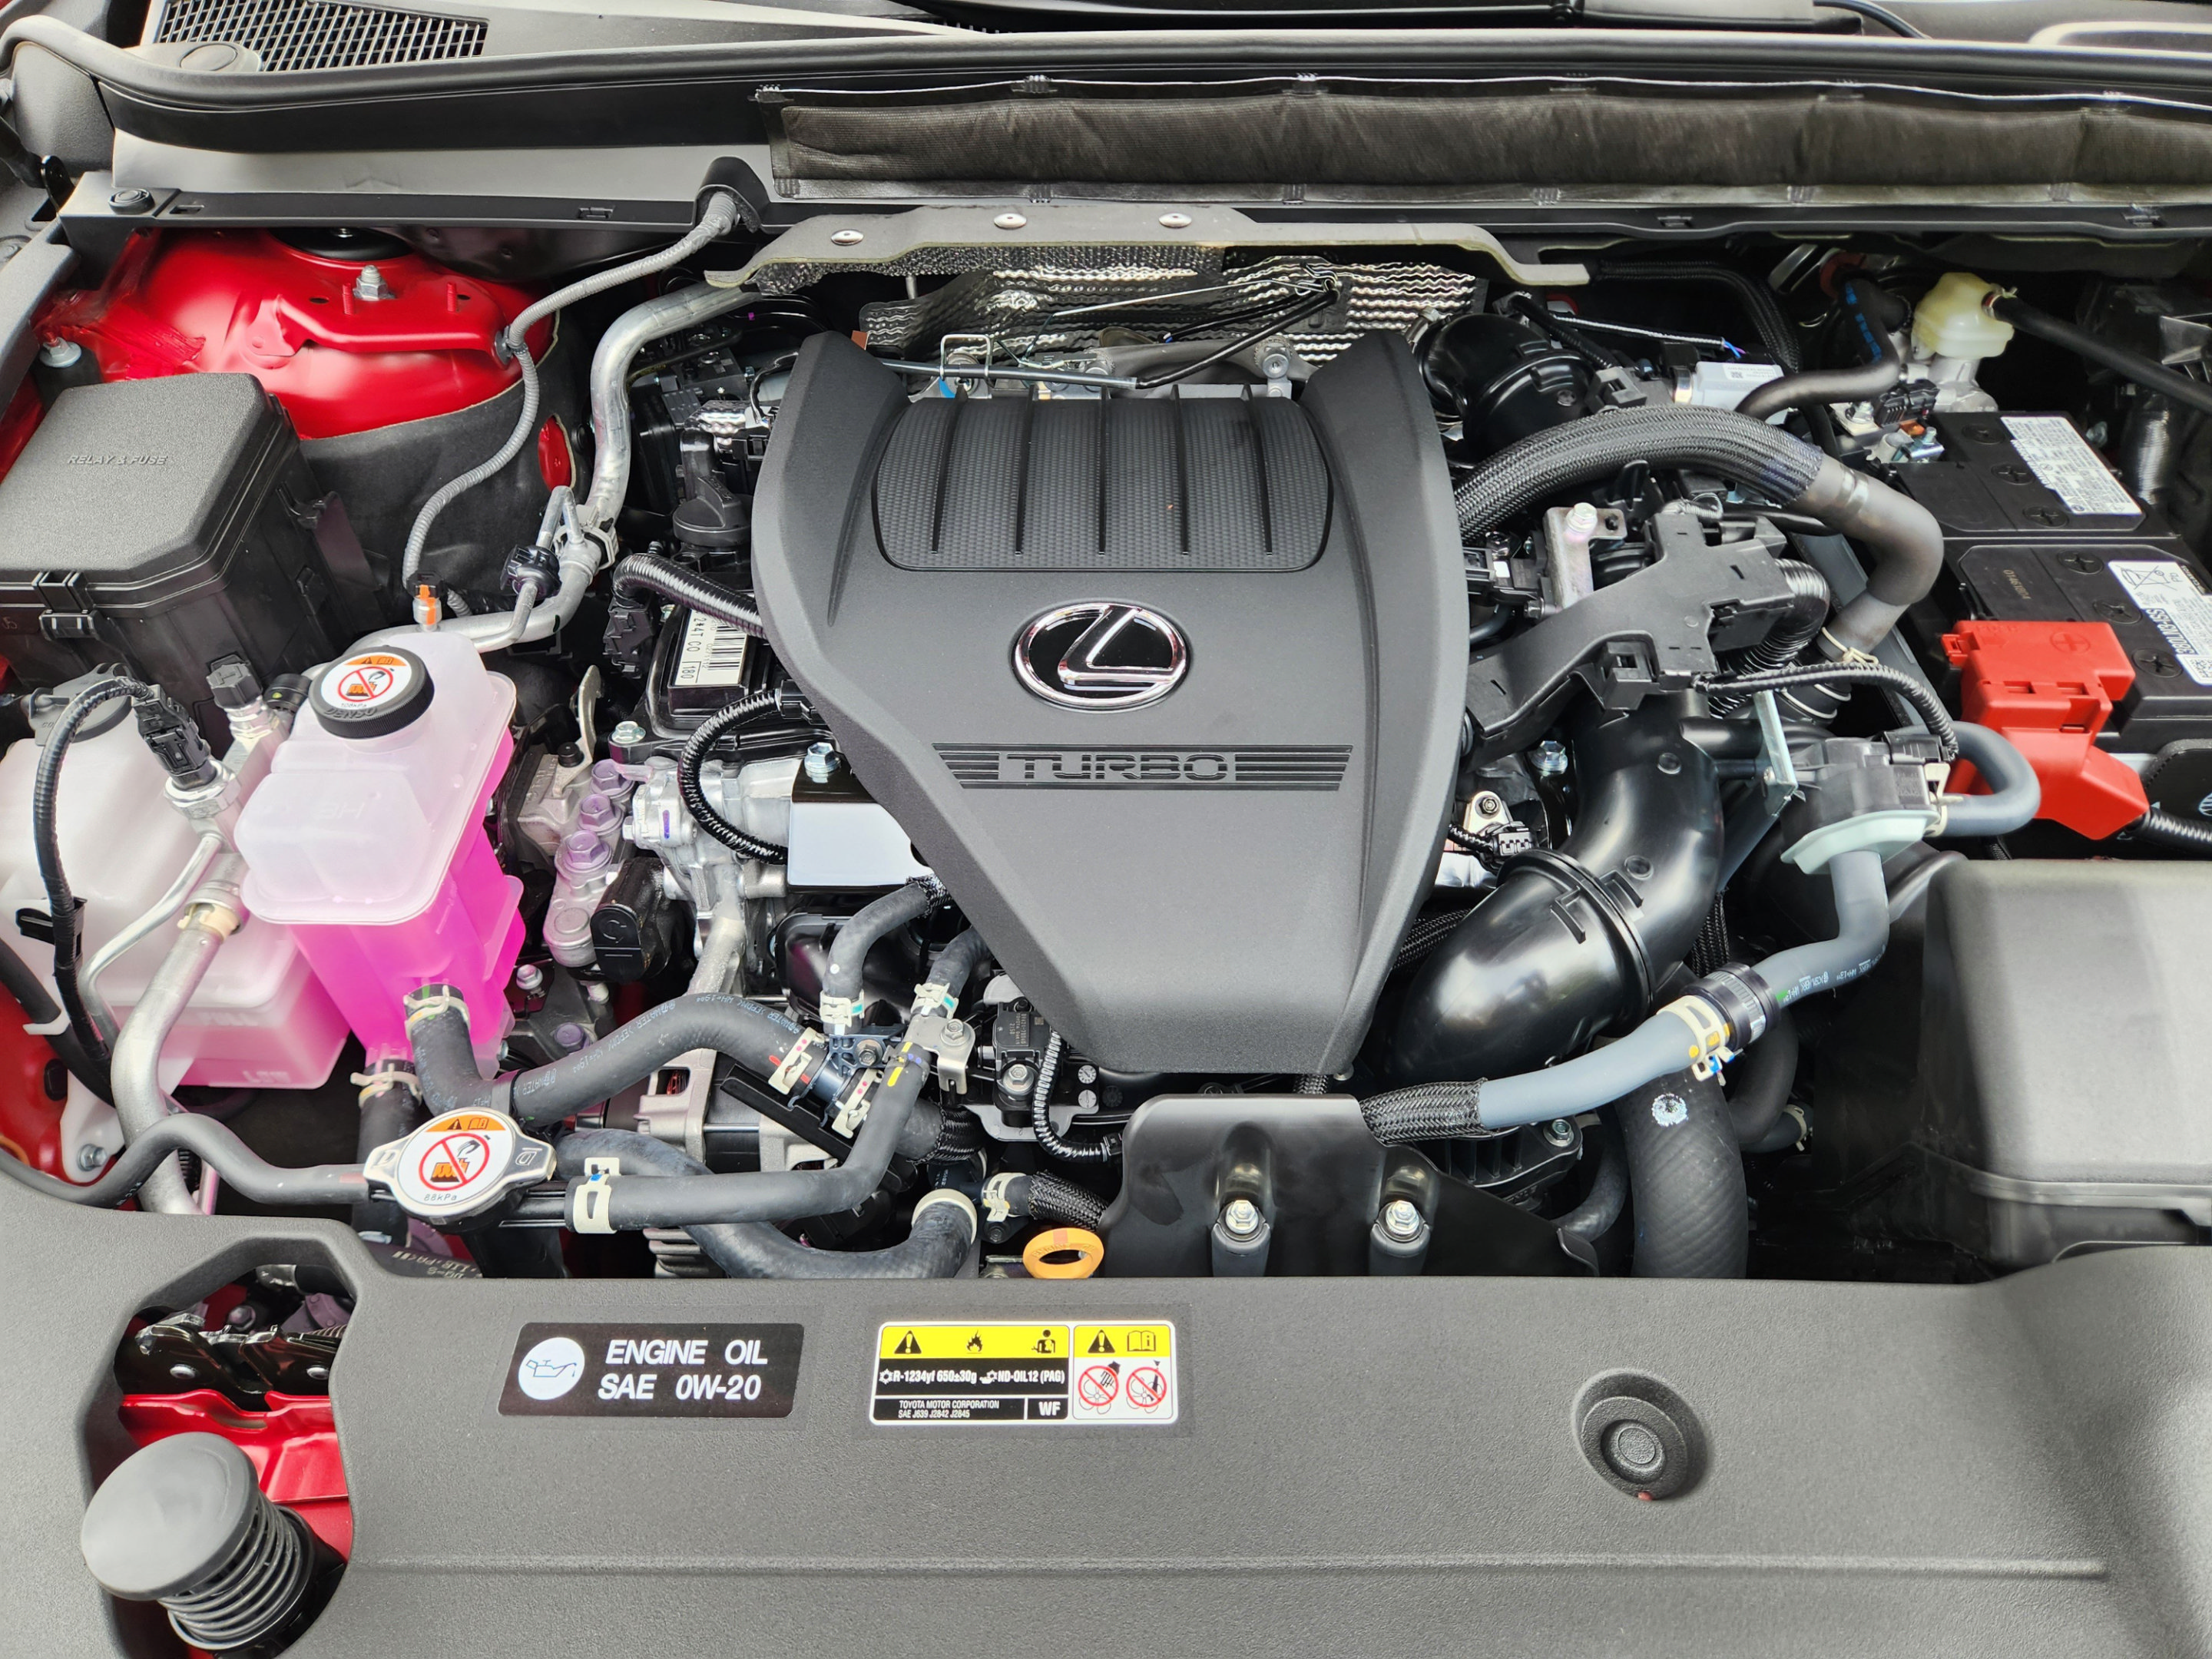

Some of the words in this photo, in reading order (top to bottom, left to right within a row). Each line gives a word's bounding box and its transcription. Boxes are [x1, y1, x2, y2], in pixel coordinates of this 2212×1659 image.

[68, 455, 115, 465] RELAY
[118, 455, 127, 465] &
[130, 455, 168, 465] FUSE
[680, 666, 696, 679] 180
[325, 707, 377, 719] DENSO
[1007, 753, 1229, 781] TURBO
[424, 1193, 457, 1201] 88kPa
[605, 1339, 708, 1365] ENGINE
[724, 1339, 768, 1365] OIL
[892, 1370, 935, 1384] R-1234yf
[937, 1370, 977, 1384] 650±30g
[1040, 1370, 1065, 1384] (PAG)
[598, 1374, 657, 1400] SAE
[675, 1374, 761, 1400] 0W-20
[899, 1400, 926, 1409] TOYOTA
[926, 1400, 951, 1409] MOTOR
[952, 1400, 999, 1409] CORPORATION
[1038, 1401, 1061, 1416] WF
[912, 1410, 929, 1419] J639
[929, 1409, 949, 1419] J2842
[950, 1410, 970, 1419] J2845
